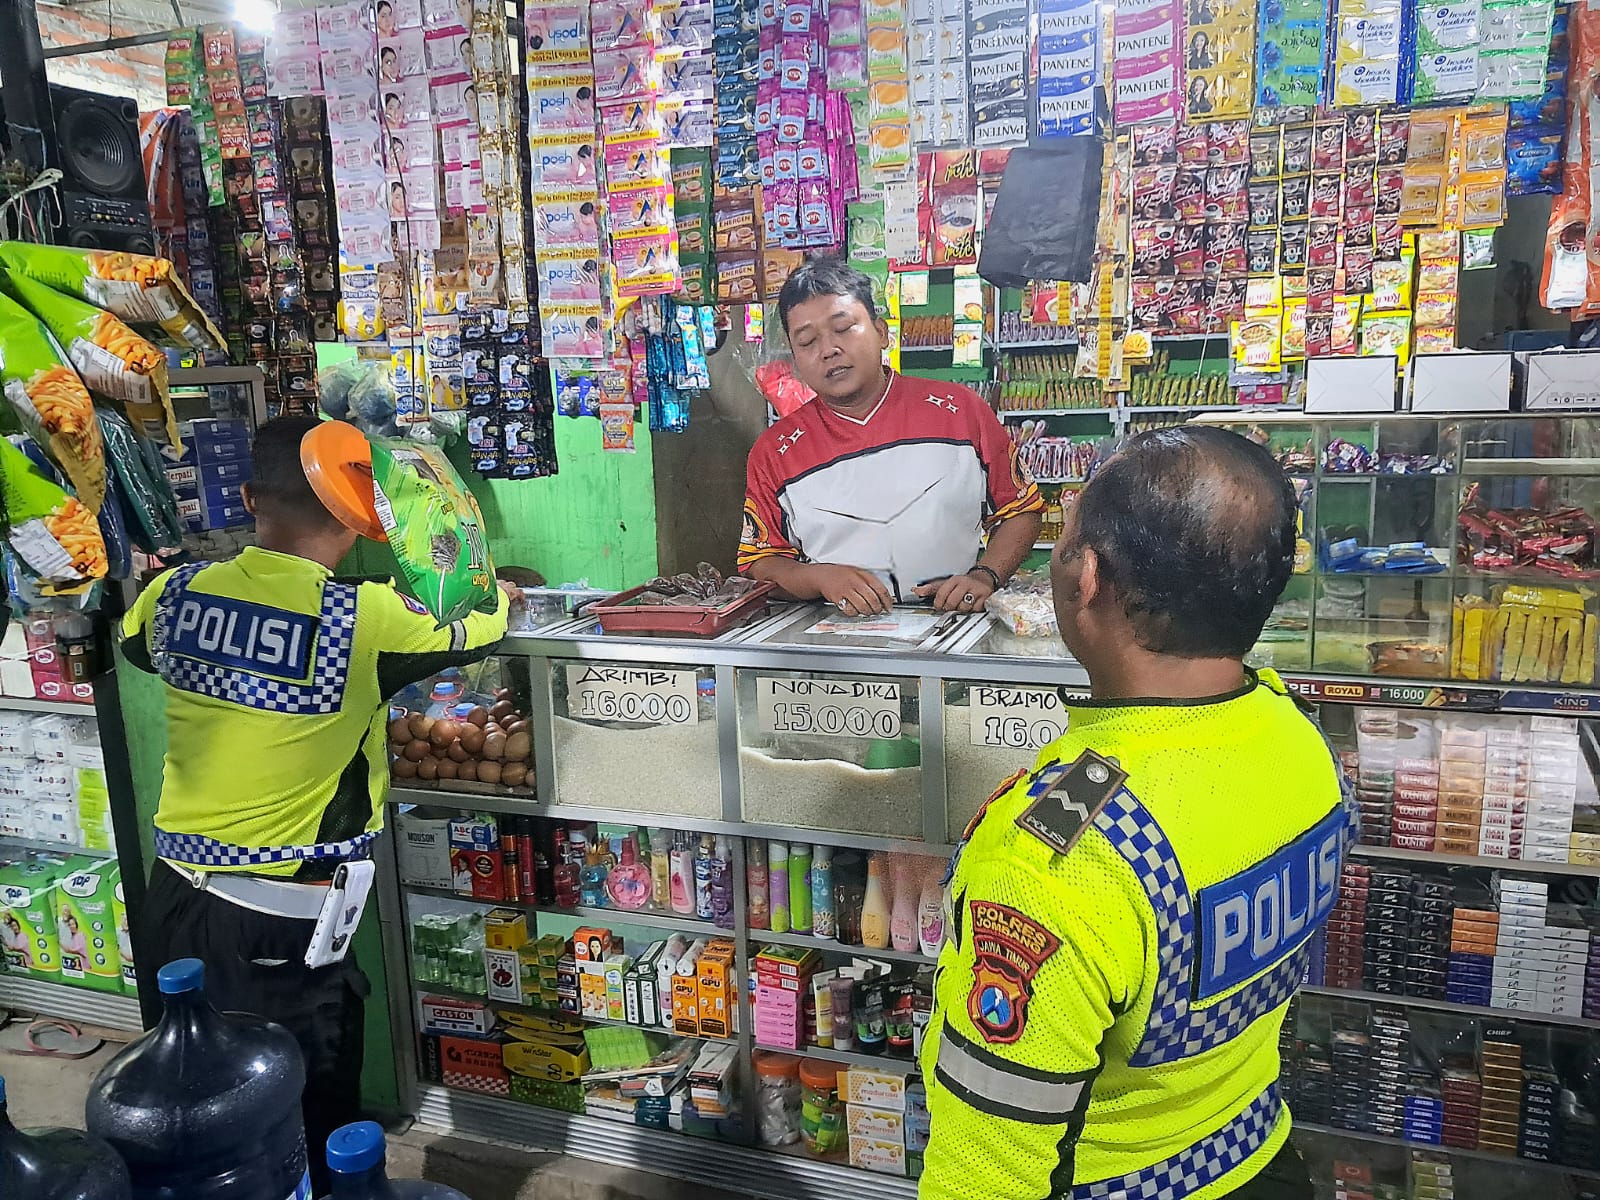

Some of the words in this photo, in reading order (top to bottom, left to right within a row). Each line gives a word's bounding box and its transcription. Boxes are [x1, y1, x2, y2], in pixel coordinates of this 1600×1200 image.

[1043, 14, 1092, 30] PANTENE
[1118, 34, 1170, 53] PANTENE
[1281, 36, 1319, 51] Rejoice
[1119, 78, 1171, 95] PANTENE
[1043, 99, 1090, 113] PANTENE
[673, 167, 700, 179] NERGEN
[718, 215, 751, 229] ENERGEN
[721, 267, 753, 279] ENERGEN
[1290, 312, 1306, 322] Rac
[174, 601, 303, 668] POLISI
[576, 666, 677, 688] ARIMBI
[772, 680, 848, 696] NONA
[850, 682, 899, 701] DIKA
[1327, 686, 1362, 696] ROYAL
[1389, 688, 1425, 700] 16.000
[976, 687, 1058, 710] BRAMO
[1553, 696, 1589, 707] KING
[581, 690, 692, 723] 16.000
[773, 702, 902, 739] 15.000
[984, 716, 1069, 749] 16.0
[454, 826, 471, 834] ABC
[71, 875, 91, 887] TOP
[976, 906, 1047, 948] POLRES
[976, 918, 1042, 955] JOMBANG
[980, 942, 1002, 955] JAWA
[1006, 948, 1031, 974] TIMUR
[676, 984, 693, 994] GPU
[701, 978, 721, 988] GPU
[434, 1009, 473, 1020] CASTOL
[1529, 1084, 1553, 1093] ZIGA
